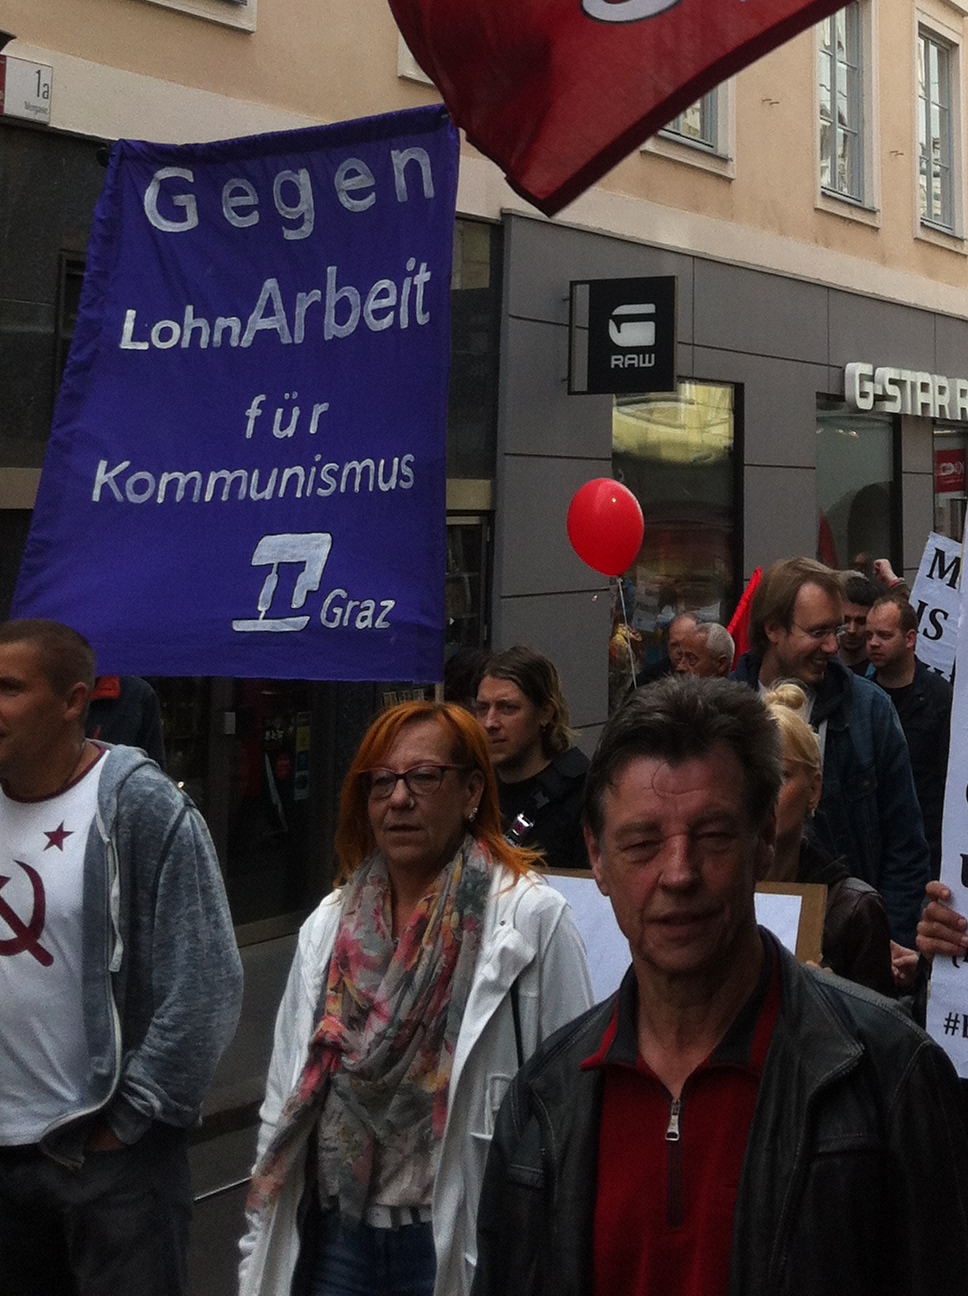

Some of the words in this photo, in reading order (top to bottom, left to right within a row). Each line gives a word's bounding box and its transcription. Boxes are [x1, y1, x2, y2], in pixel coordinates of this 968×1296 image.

[35, 69, 51, 100] 1a
[144, 146, 436, 241] Gegen
[119, 257, 432, 352] LohnArbeit
[610, 353, 655, 369] RAW
[244, 391, 330, 441] für
[845, 362, 950, 419] G-STAR
[92, 452, 415, 505] Kommunismus
[320, 588, 396, 630] Graz
